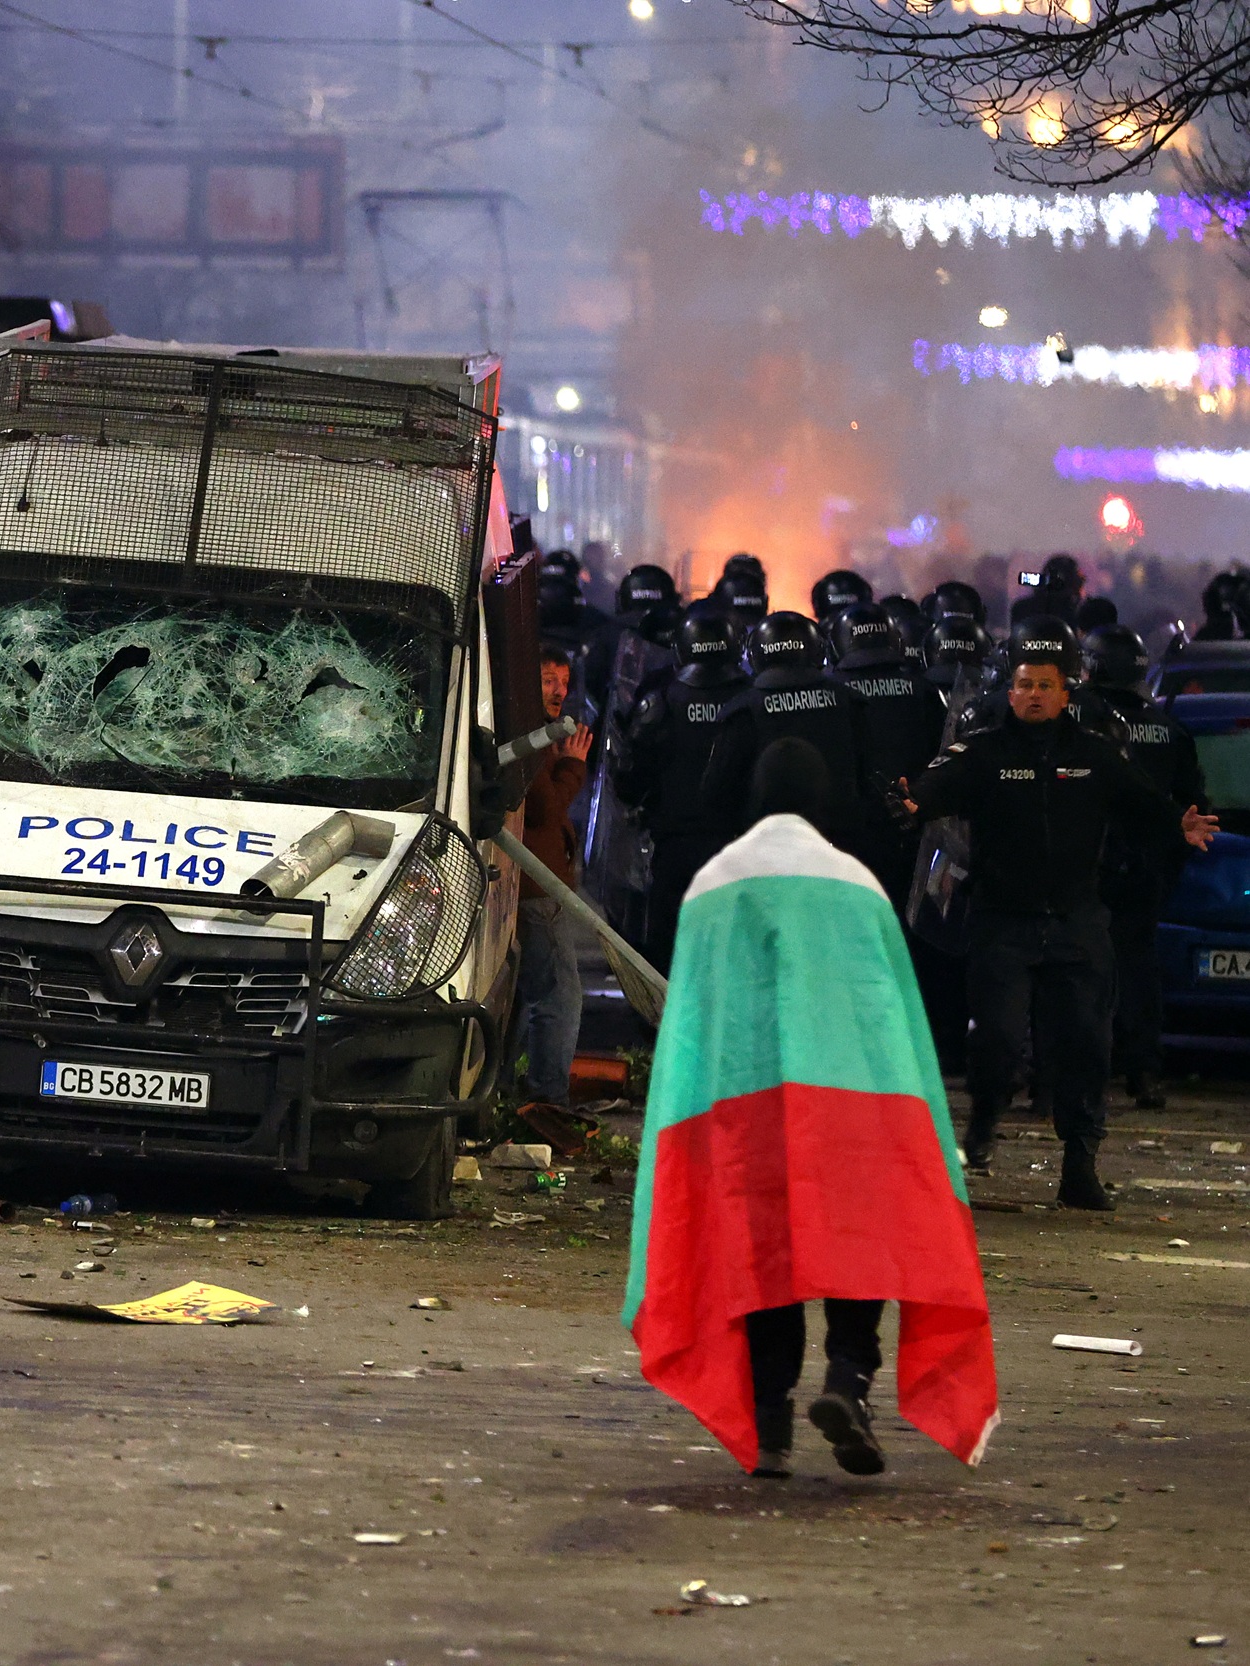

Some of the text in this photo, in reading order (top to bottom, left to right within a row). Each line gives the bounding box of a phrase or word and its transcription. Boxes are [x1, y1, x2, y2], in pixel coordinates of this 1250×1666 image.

[845, 678, 914, 697] ENDARMERY
[764, 689, 837, 714] GENDARMERY
[1000, 769, 1035, 780] 243200
[18, 816, 276, 857] POLICE
[61, 847, 225, 887] 24-1149
[1212, 954, 1239, 975] CA
[43, 1082, 55, 1091] BG
[60, 1067, 203, 1103] CB 5832 MB
